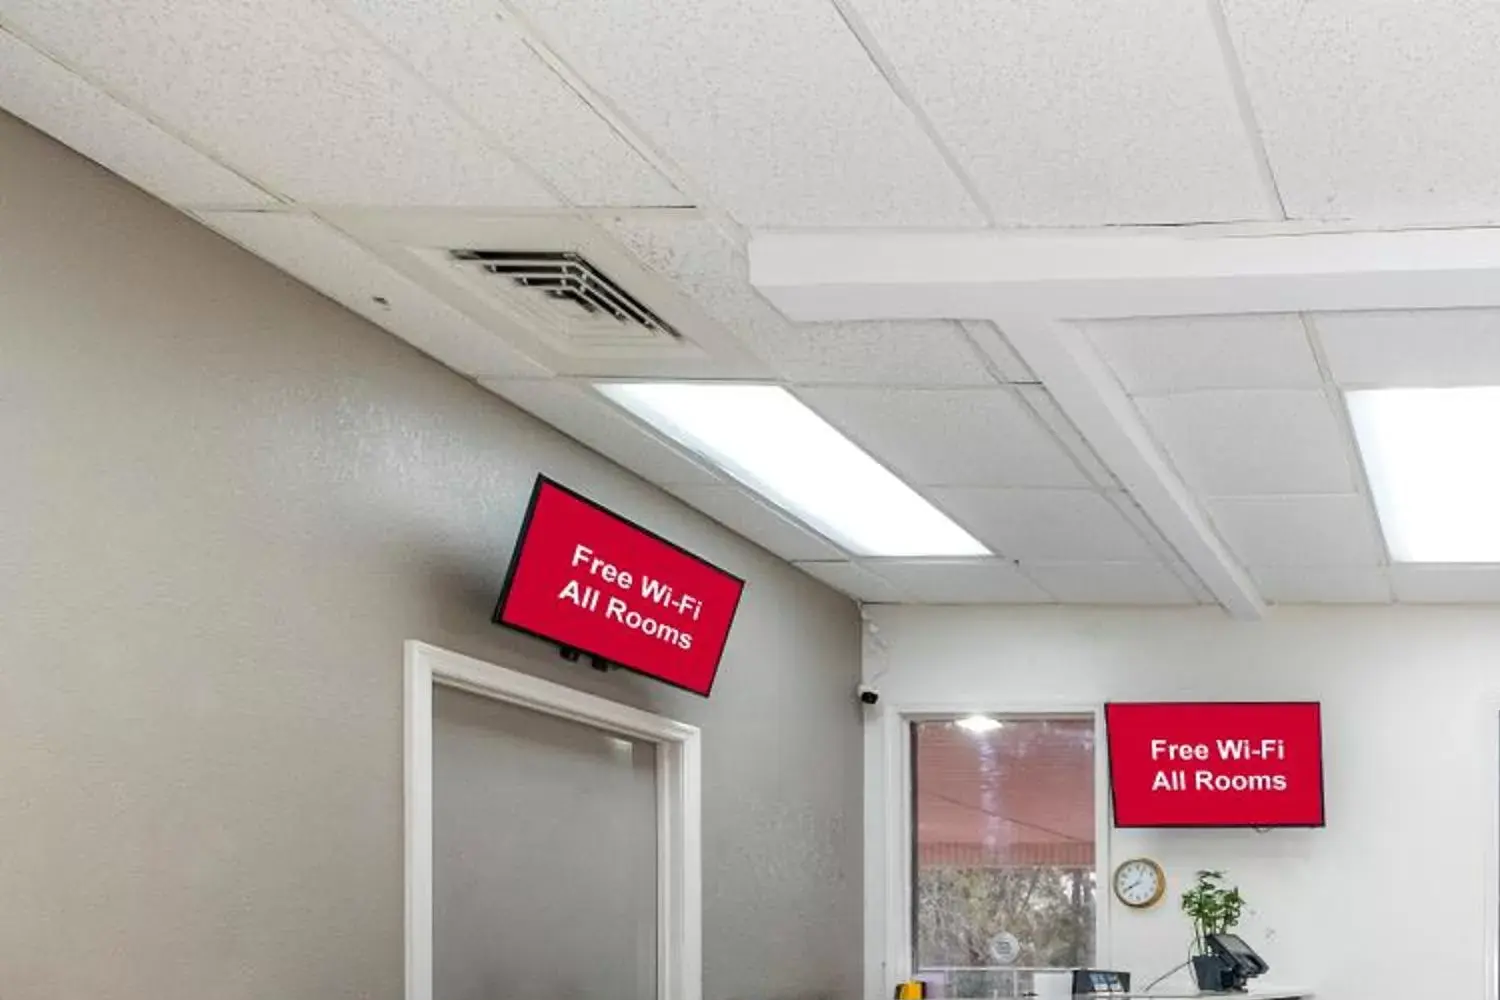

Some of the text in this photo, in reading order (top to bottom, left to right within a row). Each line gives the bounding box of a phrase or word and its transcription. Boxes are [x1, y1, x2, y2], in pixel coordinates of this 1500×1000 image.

[571, 543, 703, 621] Free Wi-Fi
[558, 579, 693, 650] All Rooms
[1151, 739, 1284, 761] Free Wi-Fi
[1151, 770, 1287, 791] All Rooms
